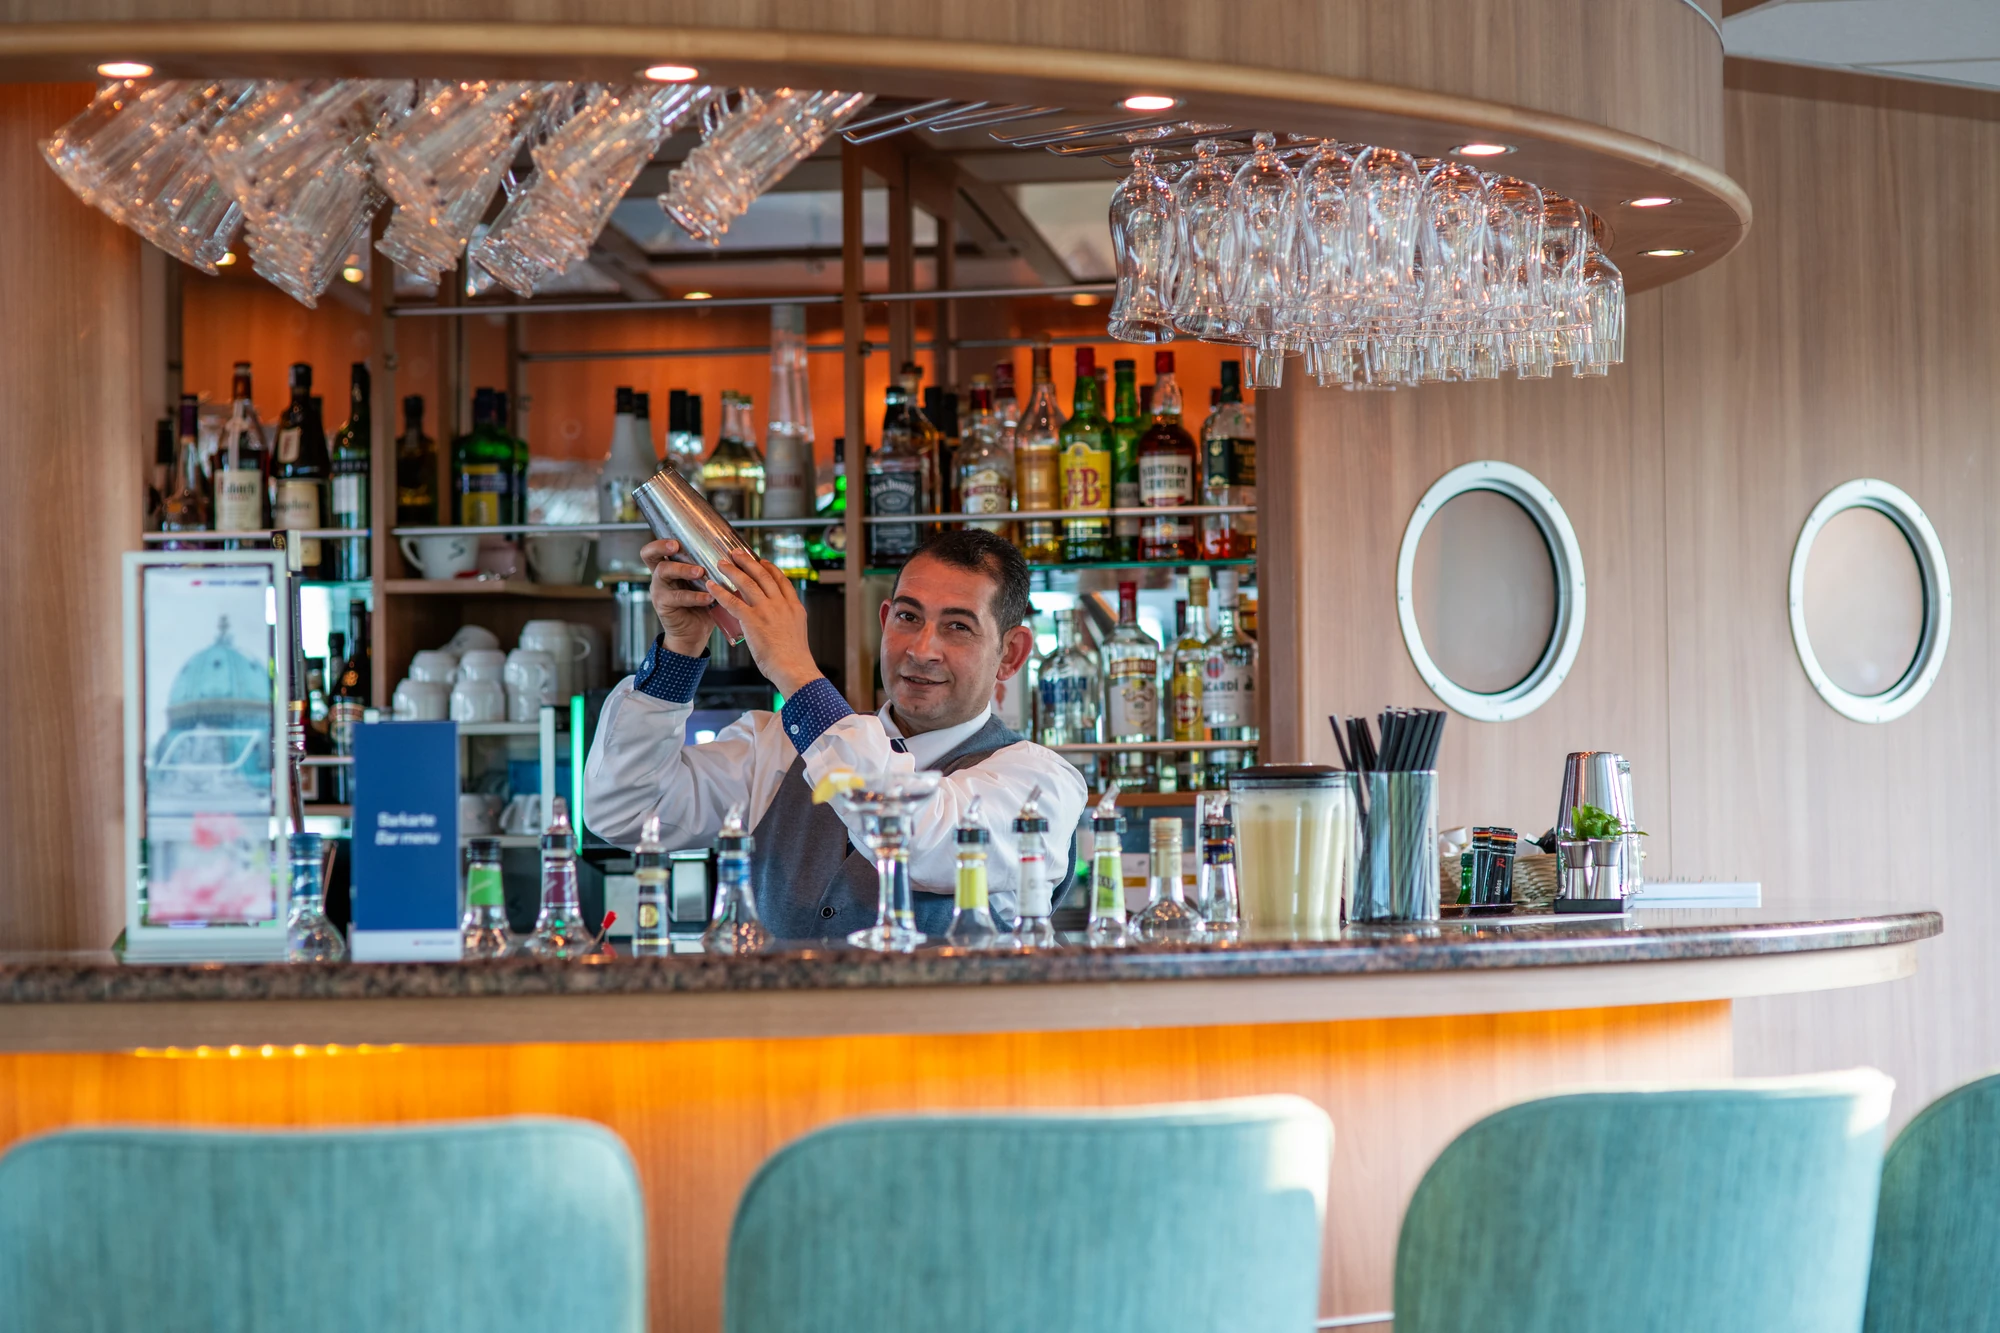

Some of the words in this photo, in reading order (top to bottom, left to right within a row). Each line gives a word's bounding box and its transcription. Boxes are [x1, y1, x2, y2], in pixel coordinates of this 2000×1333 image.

[1142, 464, 1187, 476] SOUTHERN
[1144, 479, 1186, 489] COMFORT
[1203, 679, 1239, 692] ACARDÍ
[377, 810, 437, 828] Barkarte
[375, 829, 399, 846] Bar
[400, 832, 441, 846] menu
